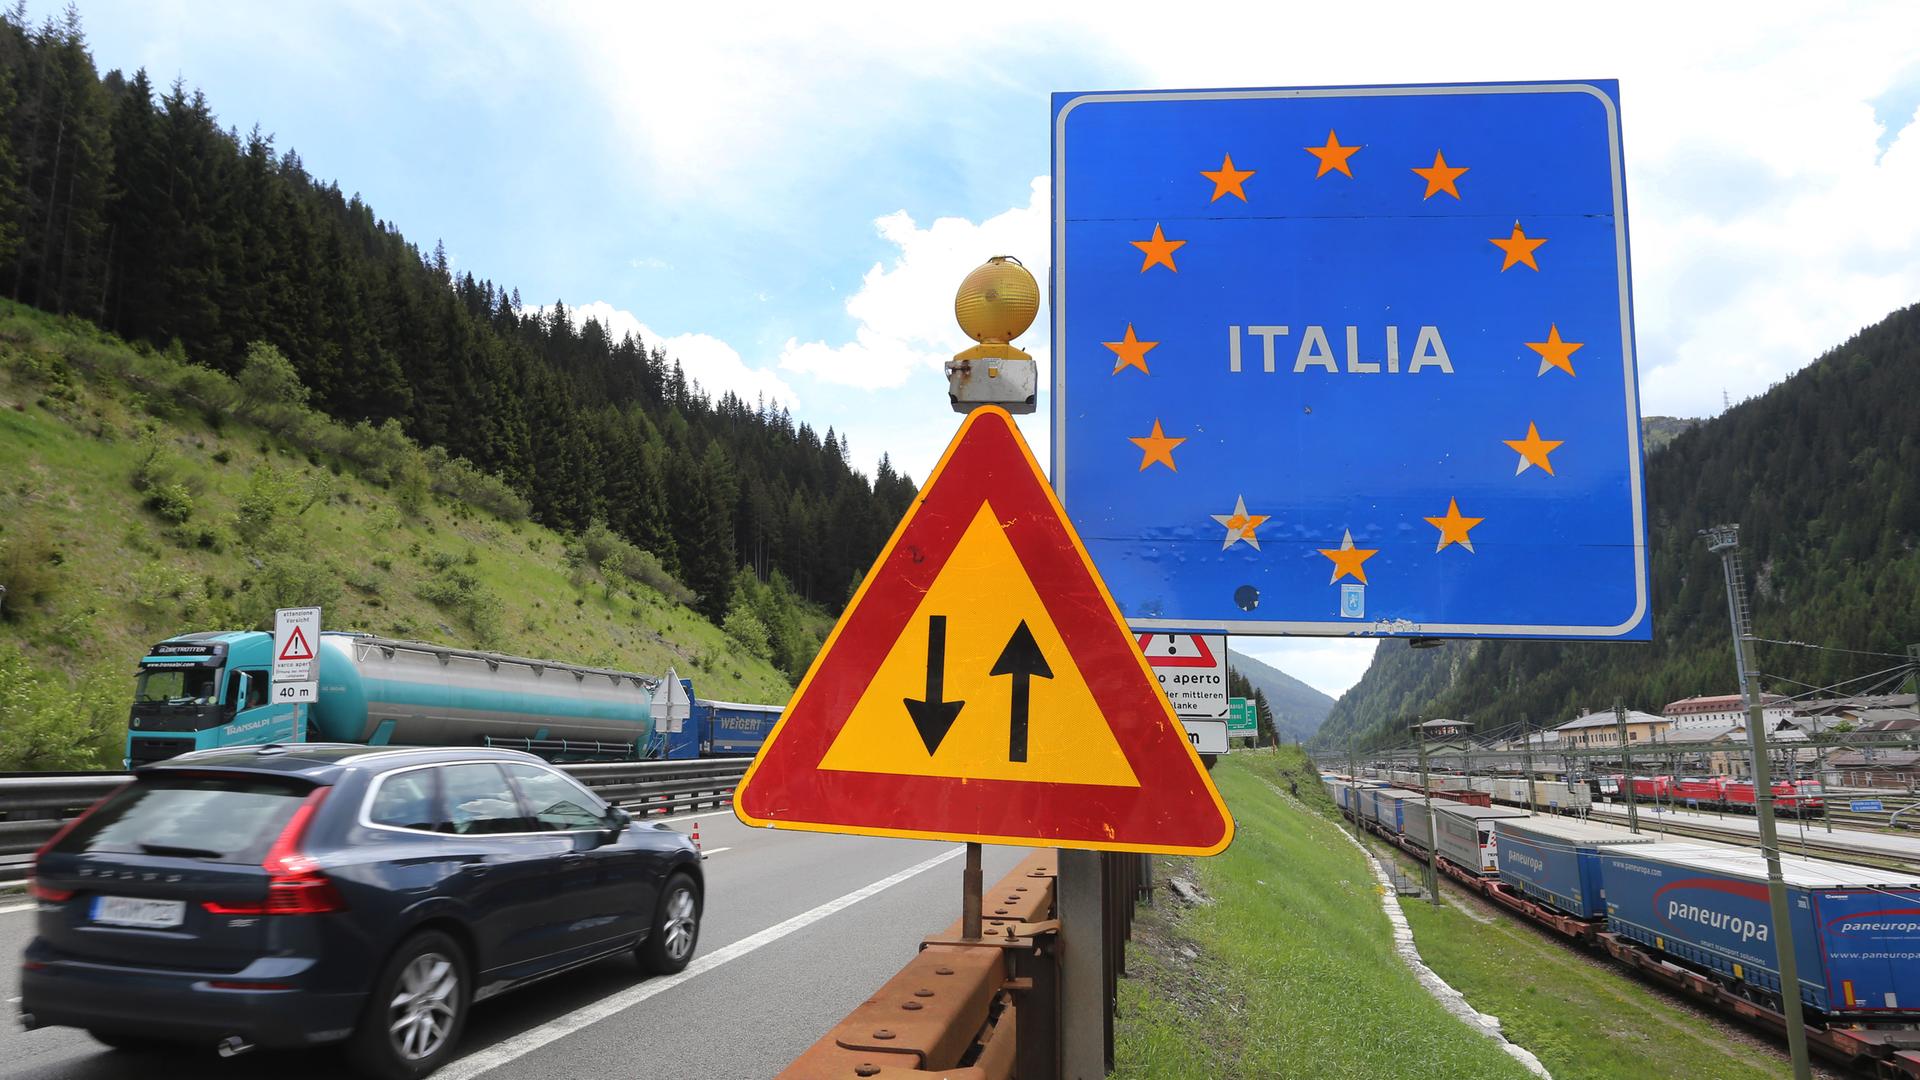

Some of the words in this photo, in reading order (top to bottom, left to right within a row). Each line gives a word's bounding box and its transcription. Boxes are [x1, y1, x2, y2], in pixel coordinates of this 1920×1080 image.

[1229, 325, 1454, 374] ITALIA
[1173, 674, 1220, 685] aperto
[279, 687, 295, 697] 40
[299, 688, 309, 697] m
[1182, 691, 1224, 699] mittleren
[1173, 701, 1198, 710] lanke
[1668, 900, 1768, 942] paneuropa
